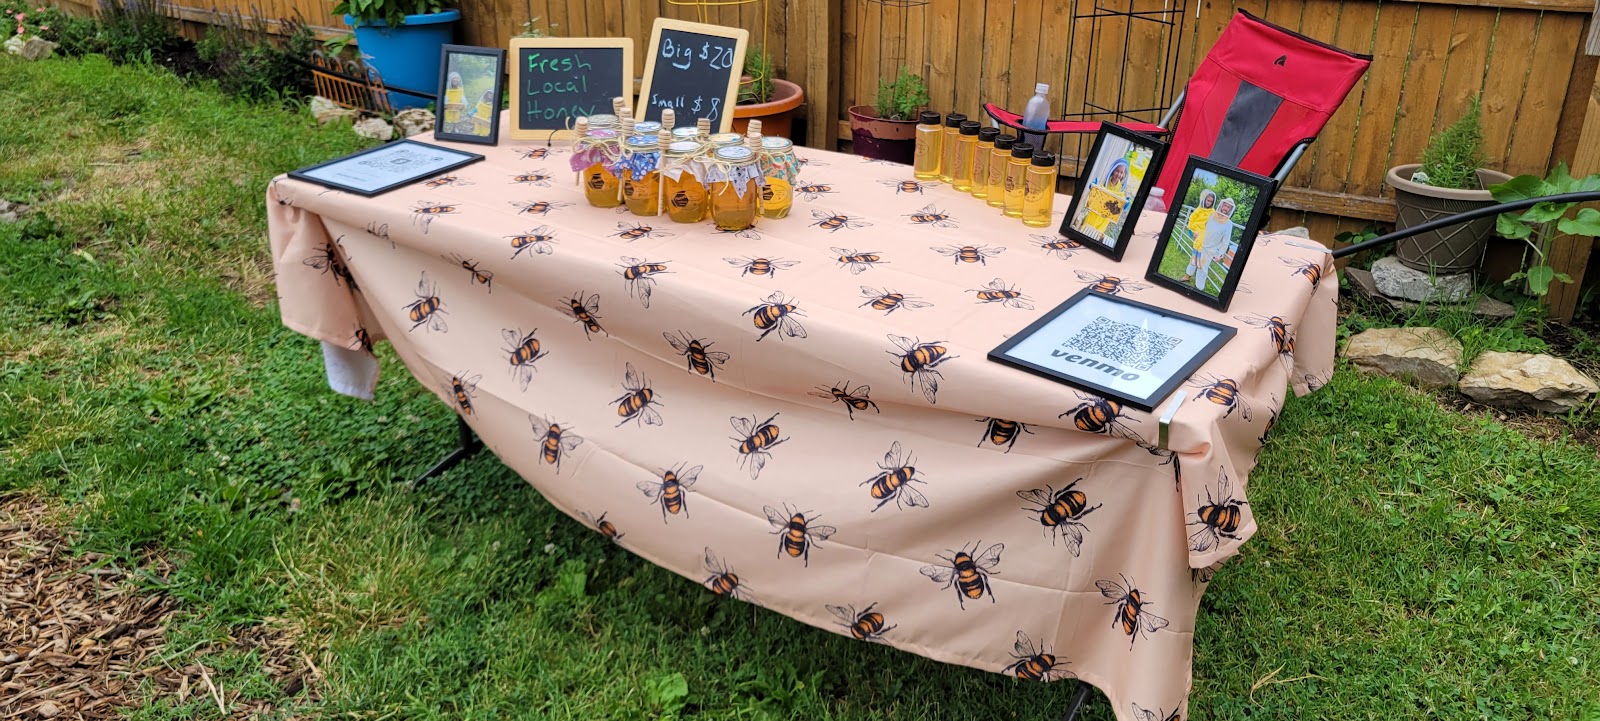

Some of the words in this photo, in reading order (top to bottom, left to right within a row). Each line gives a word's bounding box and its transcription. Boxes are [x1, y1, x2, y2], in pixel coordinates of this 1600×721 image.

[527, 53, 591, 73] Fresh
[662, 38, 692, 70] Big
[699, 41, 733, 70] $20
[527, 75, 587, 95] Local
[1051, 349, 1140, 381] venmo
